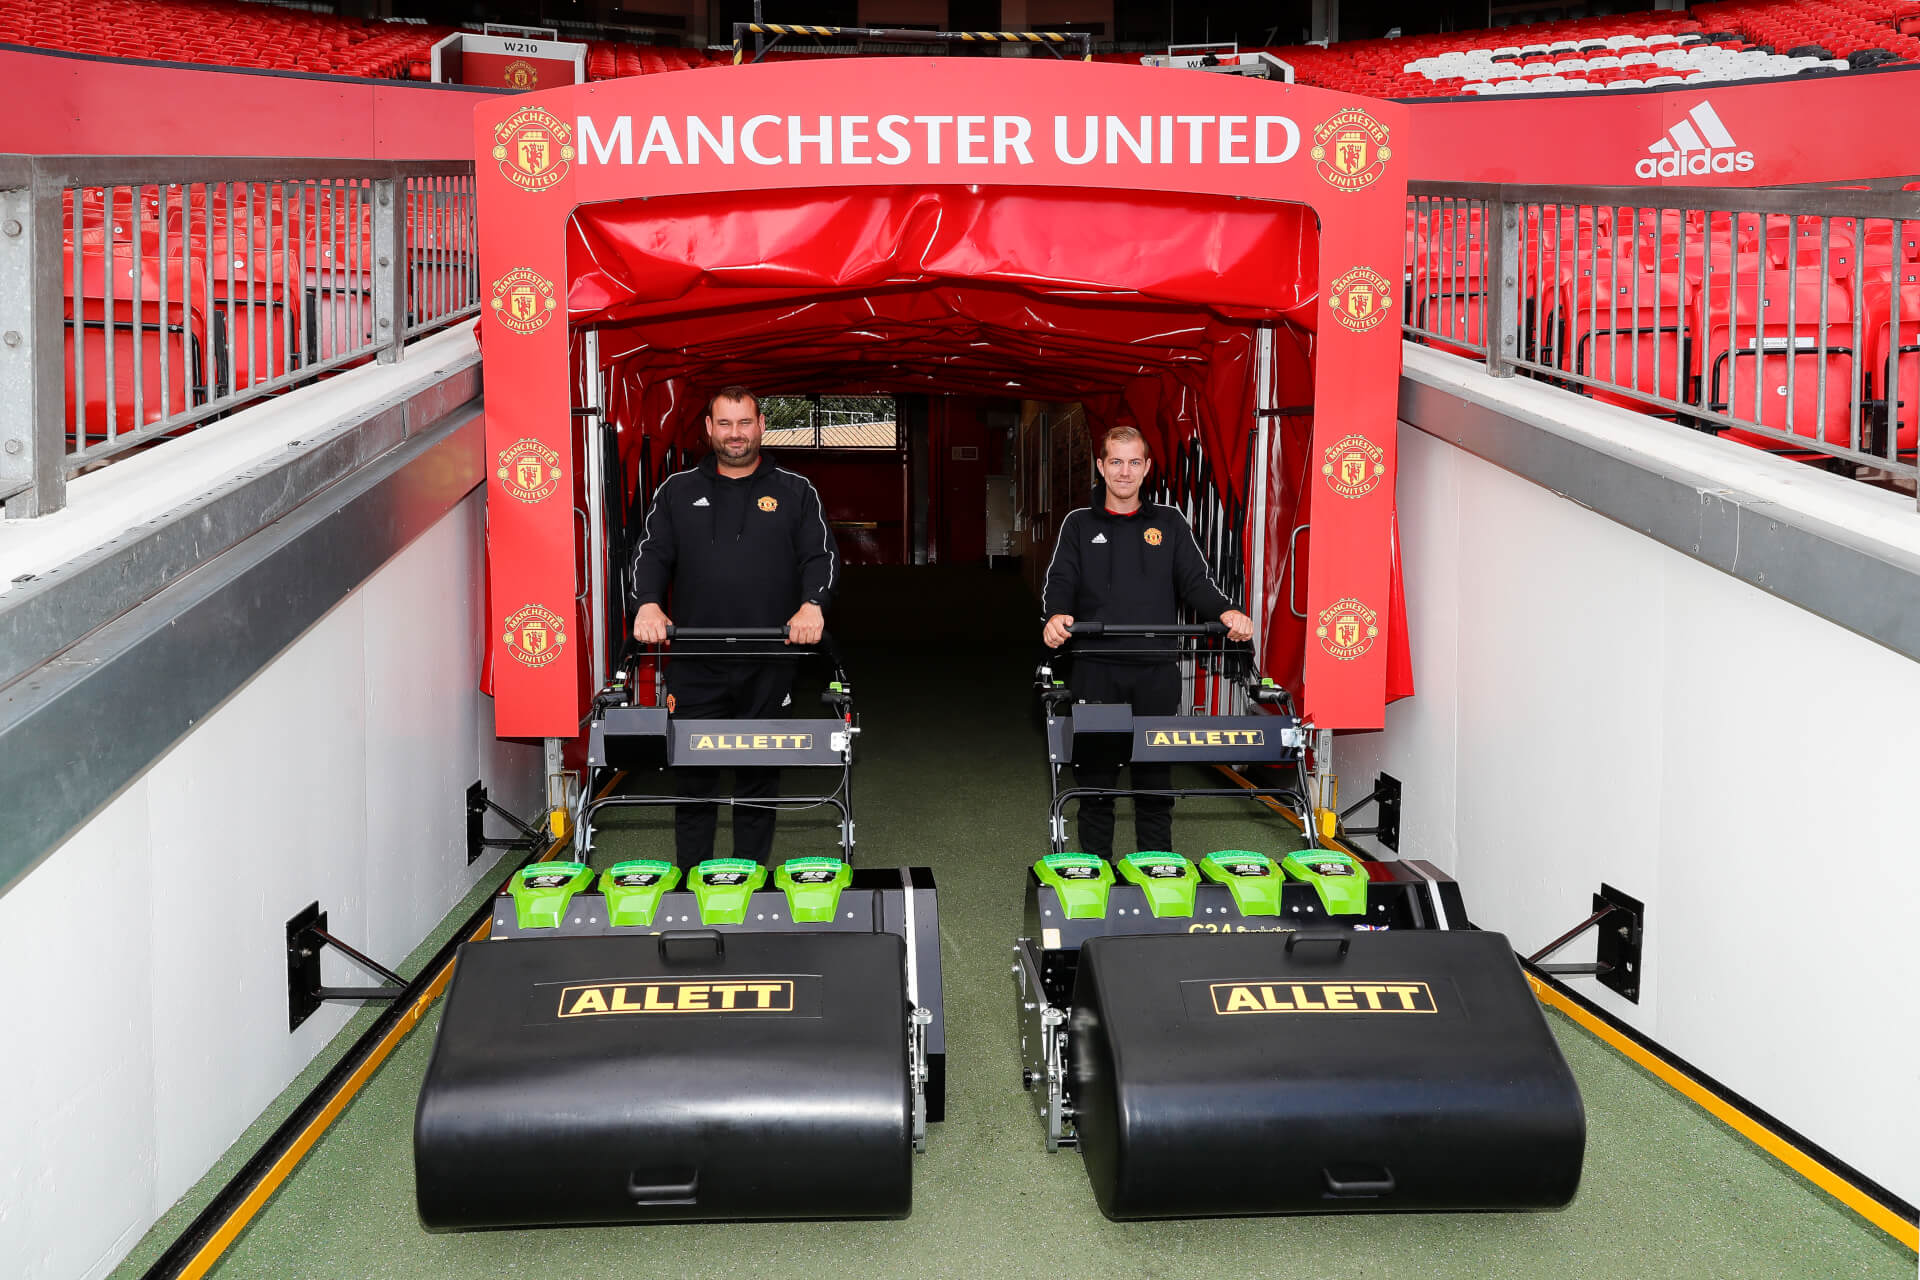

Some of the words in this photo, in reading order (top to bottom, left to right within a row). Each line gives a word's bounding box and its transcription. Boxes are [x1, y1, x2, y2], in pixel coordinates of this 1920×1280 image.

[504, 42, 538, 53] W210
[501, 110, 566, 141] MANCHESTER
[1319, 111, 1384, 142] MANCHESTER
[576, 115, 1033, 165] MANCHESTER
[1054, 115, 1301, 164] UNITED
[1635, 149, 1754, 178] adidas
[512, 172, 559, 188] UNITED
[1328, 172, 1374, 187] UNITED
[498, 272, 551, 295] MANCHESTER
[1335, 270, 1387, 294] MANCHESTER
[506, 316, 543, 331] UNITED
[1342, 314, 1379, 330] UNITED
[502, 441, 557, 466] MANCHESTER
[1328, 437, 1383, 461] MANCHESTER
[511, 486, 550, 501] UNITED
[1335, 482, 1371, 497] UNITED
[508, 606, 561, 630] MANCHESTER
[1318, 602, 1373, 625] MANCHESTER
[517, 651, 553, 666] UNITED
[1328, 645, 1365, 659] UNITED
[697, 735, 806, 750] ALLETT
[1153, 731, 1257, 745] ALLETT
[569, 984, 782, 1014] ALLETT
[1226, 985, 1420, 1012] ALLETT
